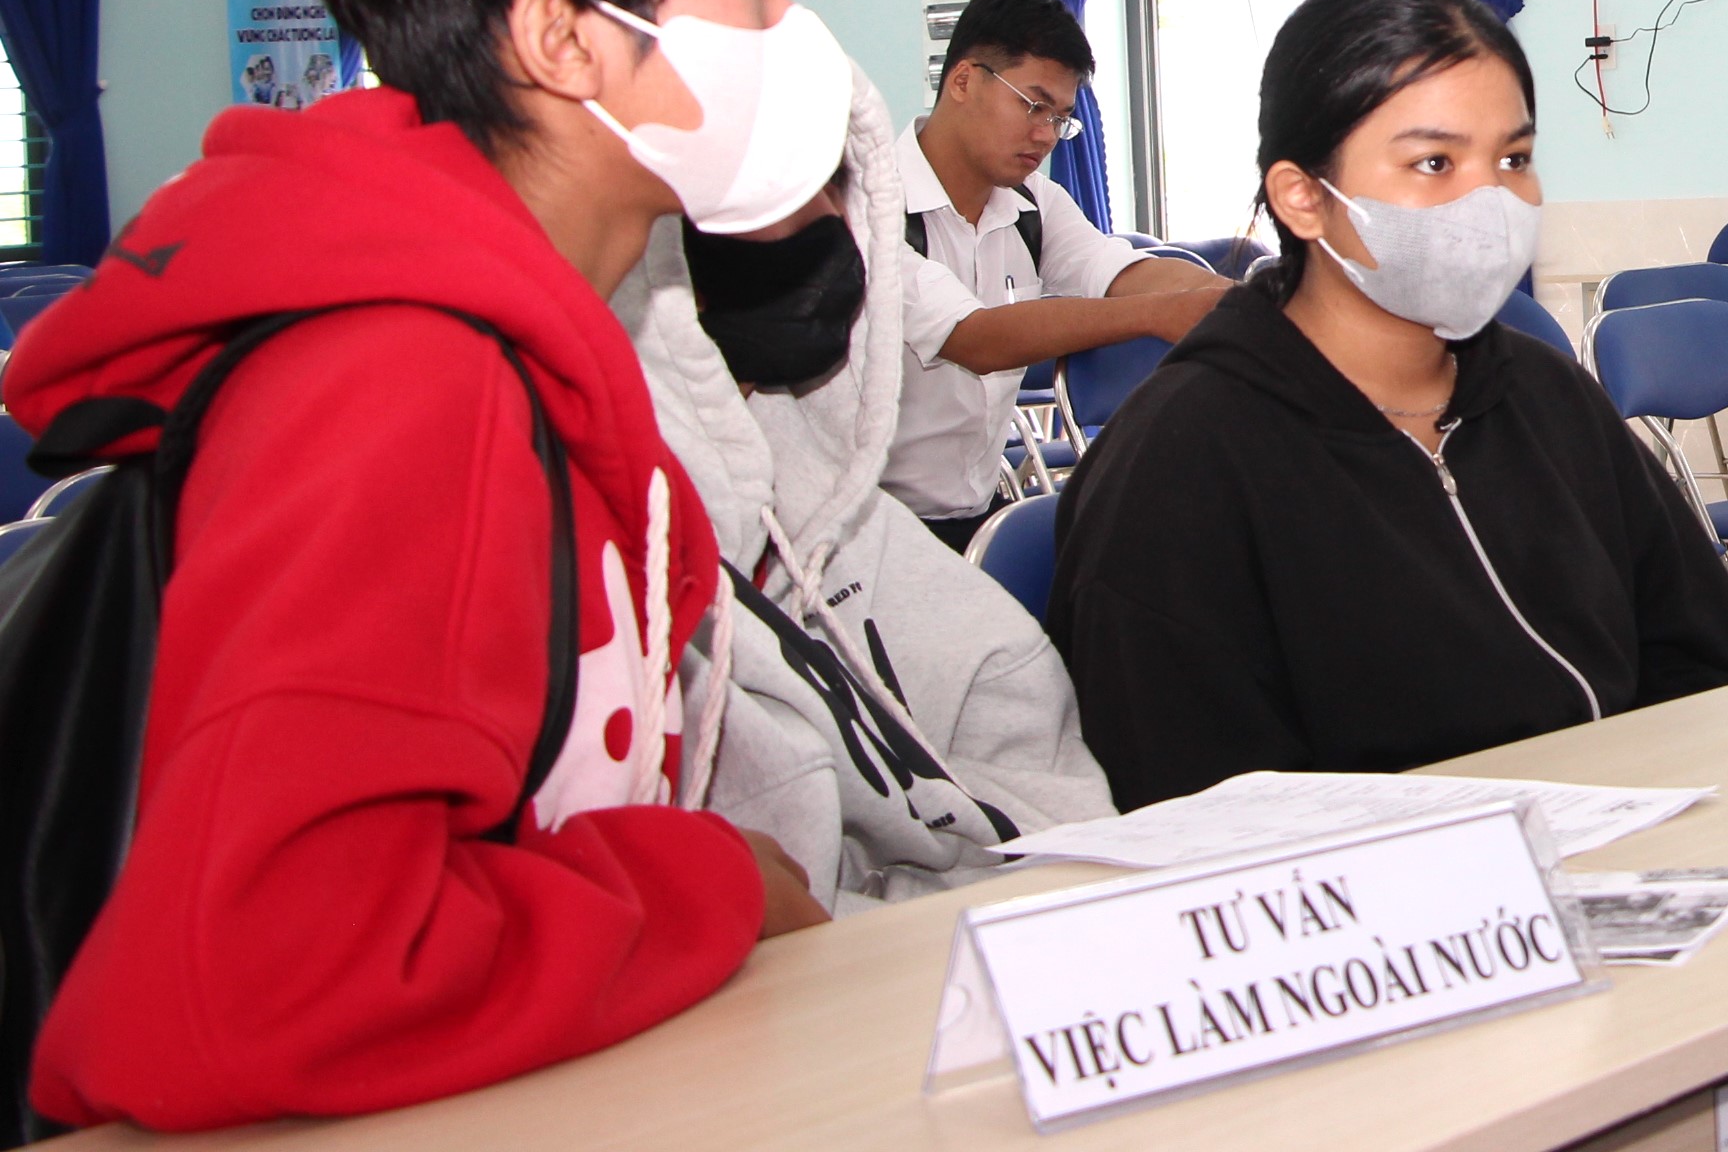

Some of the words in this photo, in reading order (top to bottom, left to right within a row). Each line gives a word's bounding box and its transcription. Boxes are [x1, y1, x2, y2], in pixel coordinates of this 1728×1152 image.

[1180, 889, 1252, 964] TƯ
[1257, 868, 1360, 944] VẤN
[1023, 1008, 1154, 1090] VIỆC
[1157, 976, 1275, 1055] LÀM
[1278, 936, 1431, 1024] NGOÀI
[1430, 904, 1562, 984] NƯỚC
